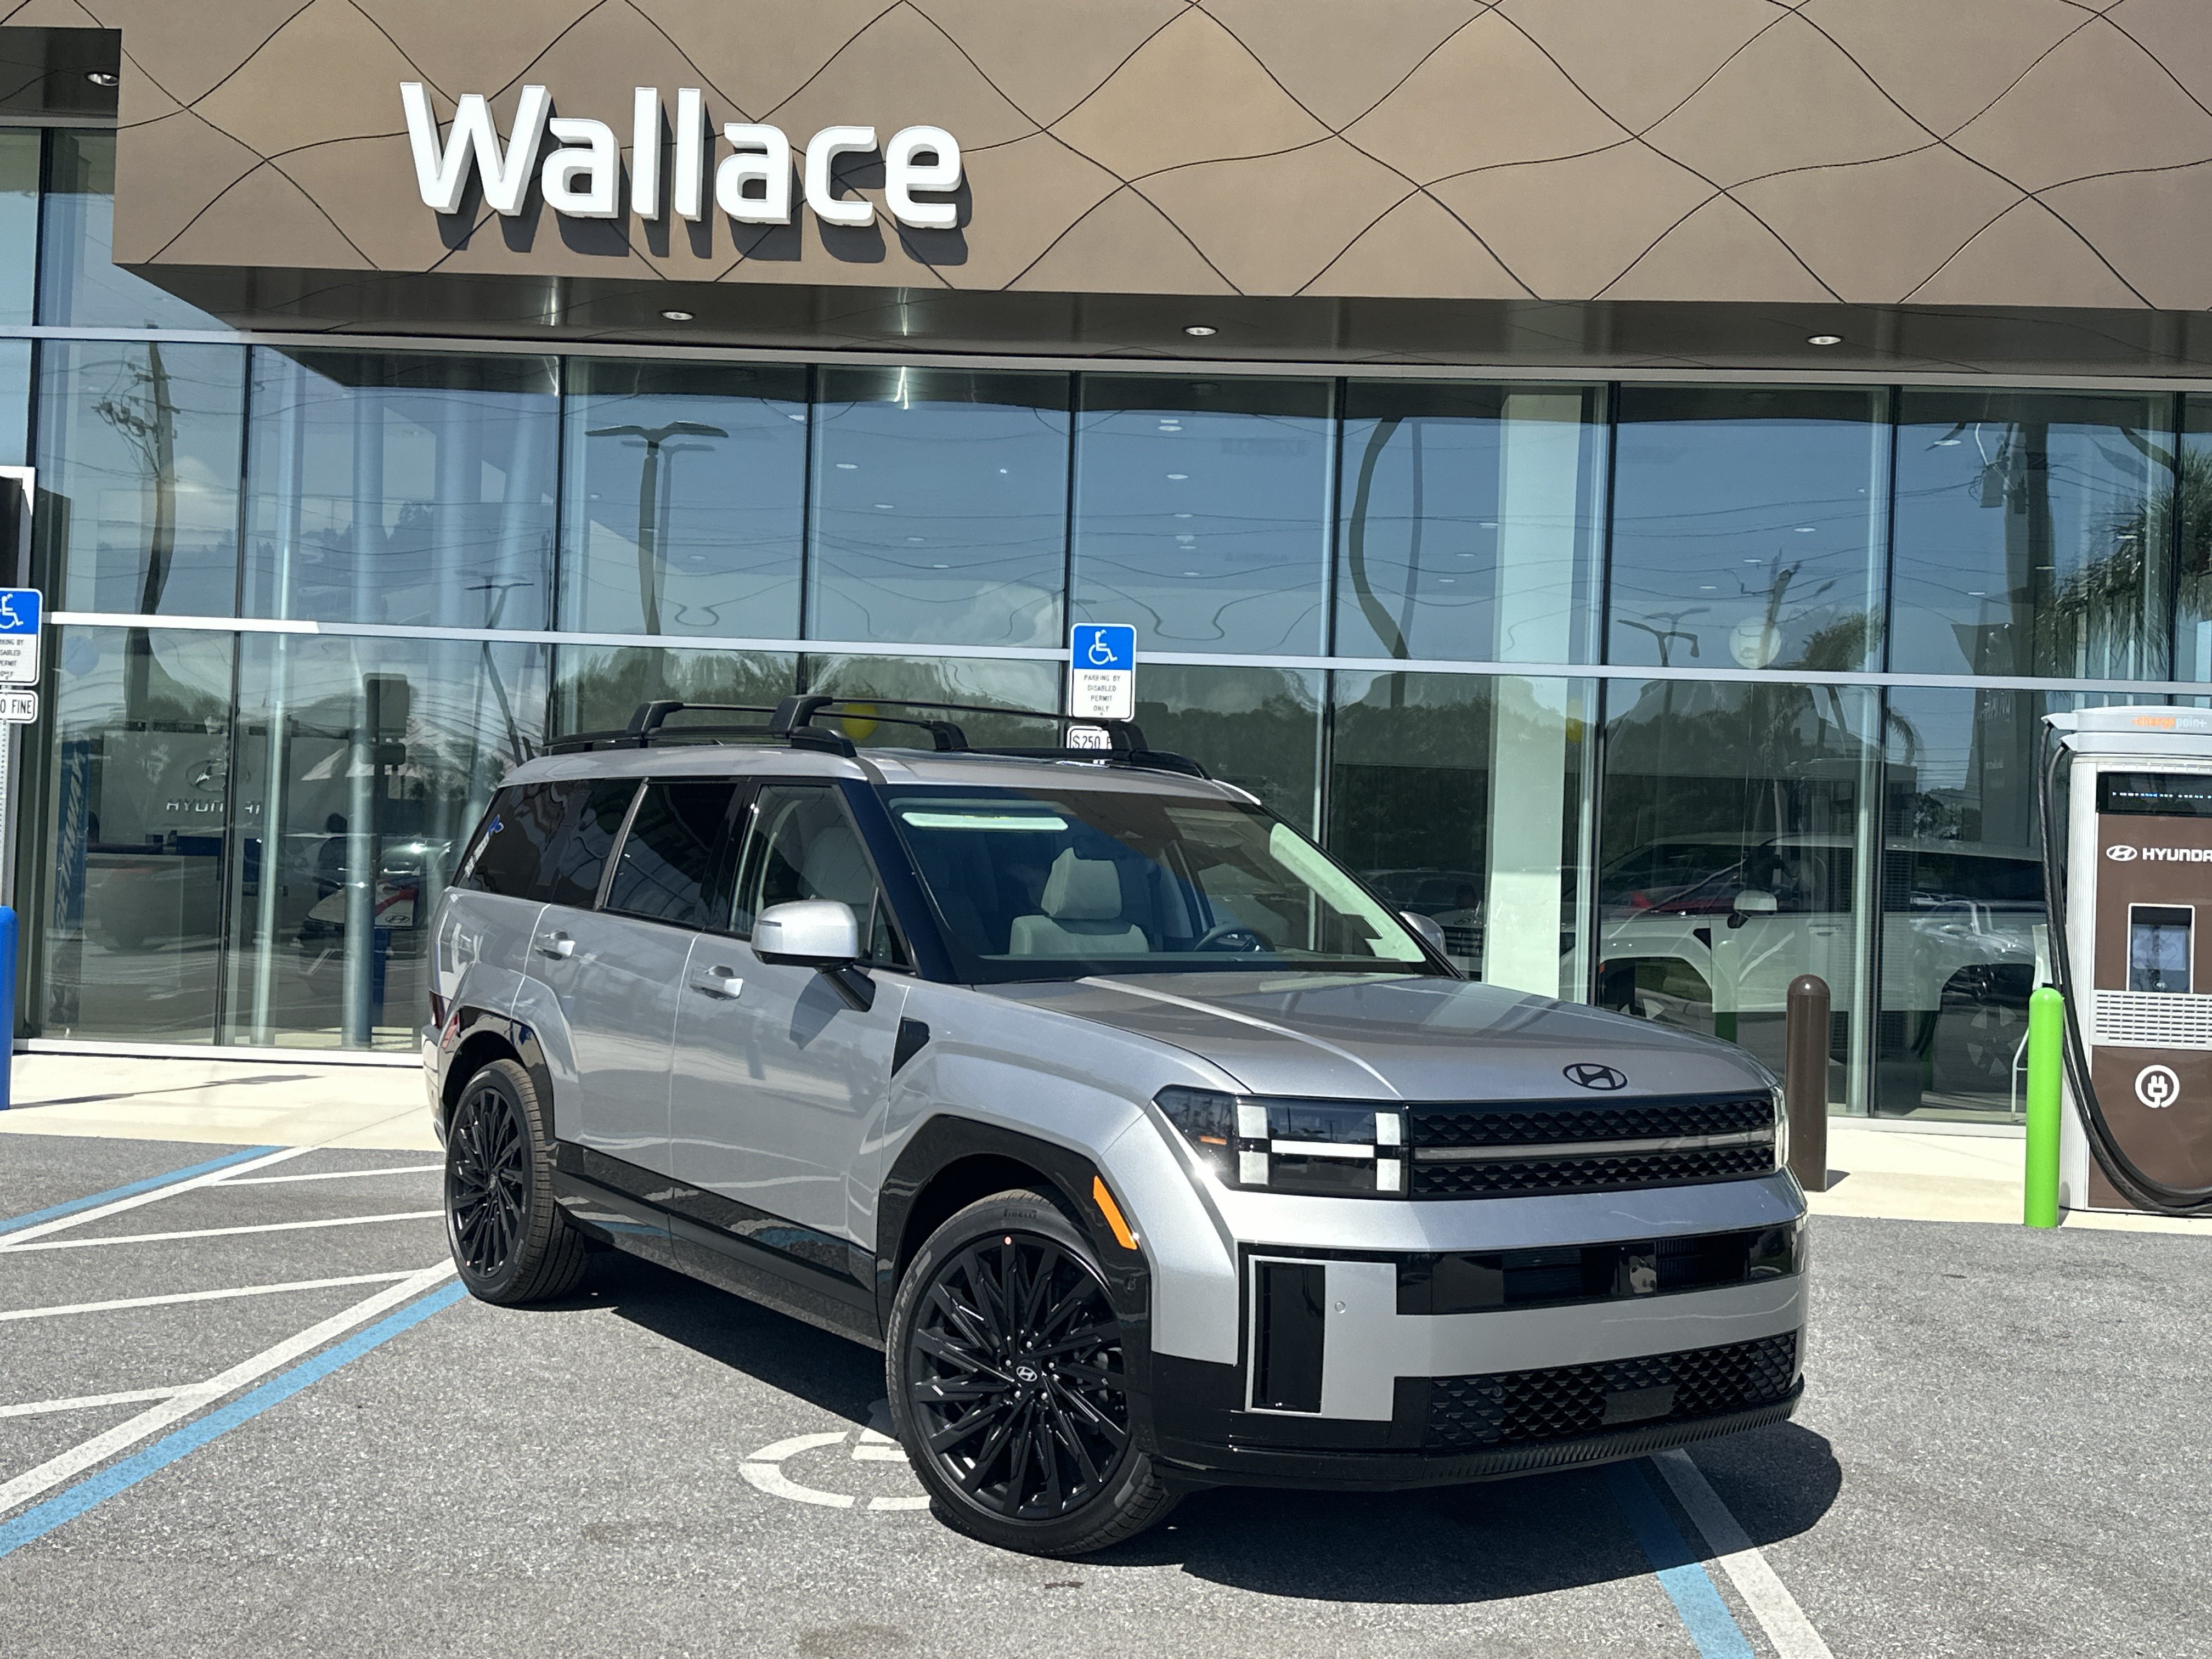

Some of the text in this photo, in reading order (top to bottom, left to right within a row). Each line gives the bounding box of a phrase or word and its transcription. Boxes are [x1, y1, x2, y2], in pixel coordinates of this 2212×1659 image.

[399, 82, 961, 229] Wallace
[12, 699, 32, 714] FINE
[1073, 735, 1101, 749] $250
[166, 799, 261, 815] HYUNAI
